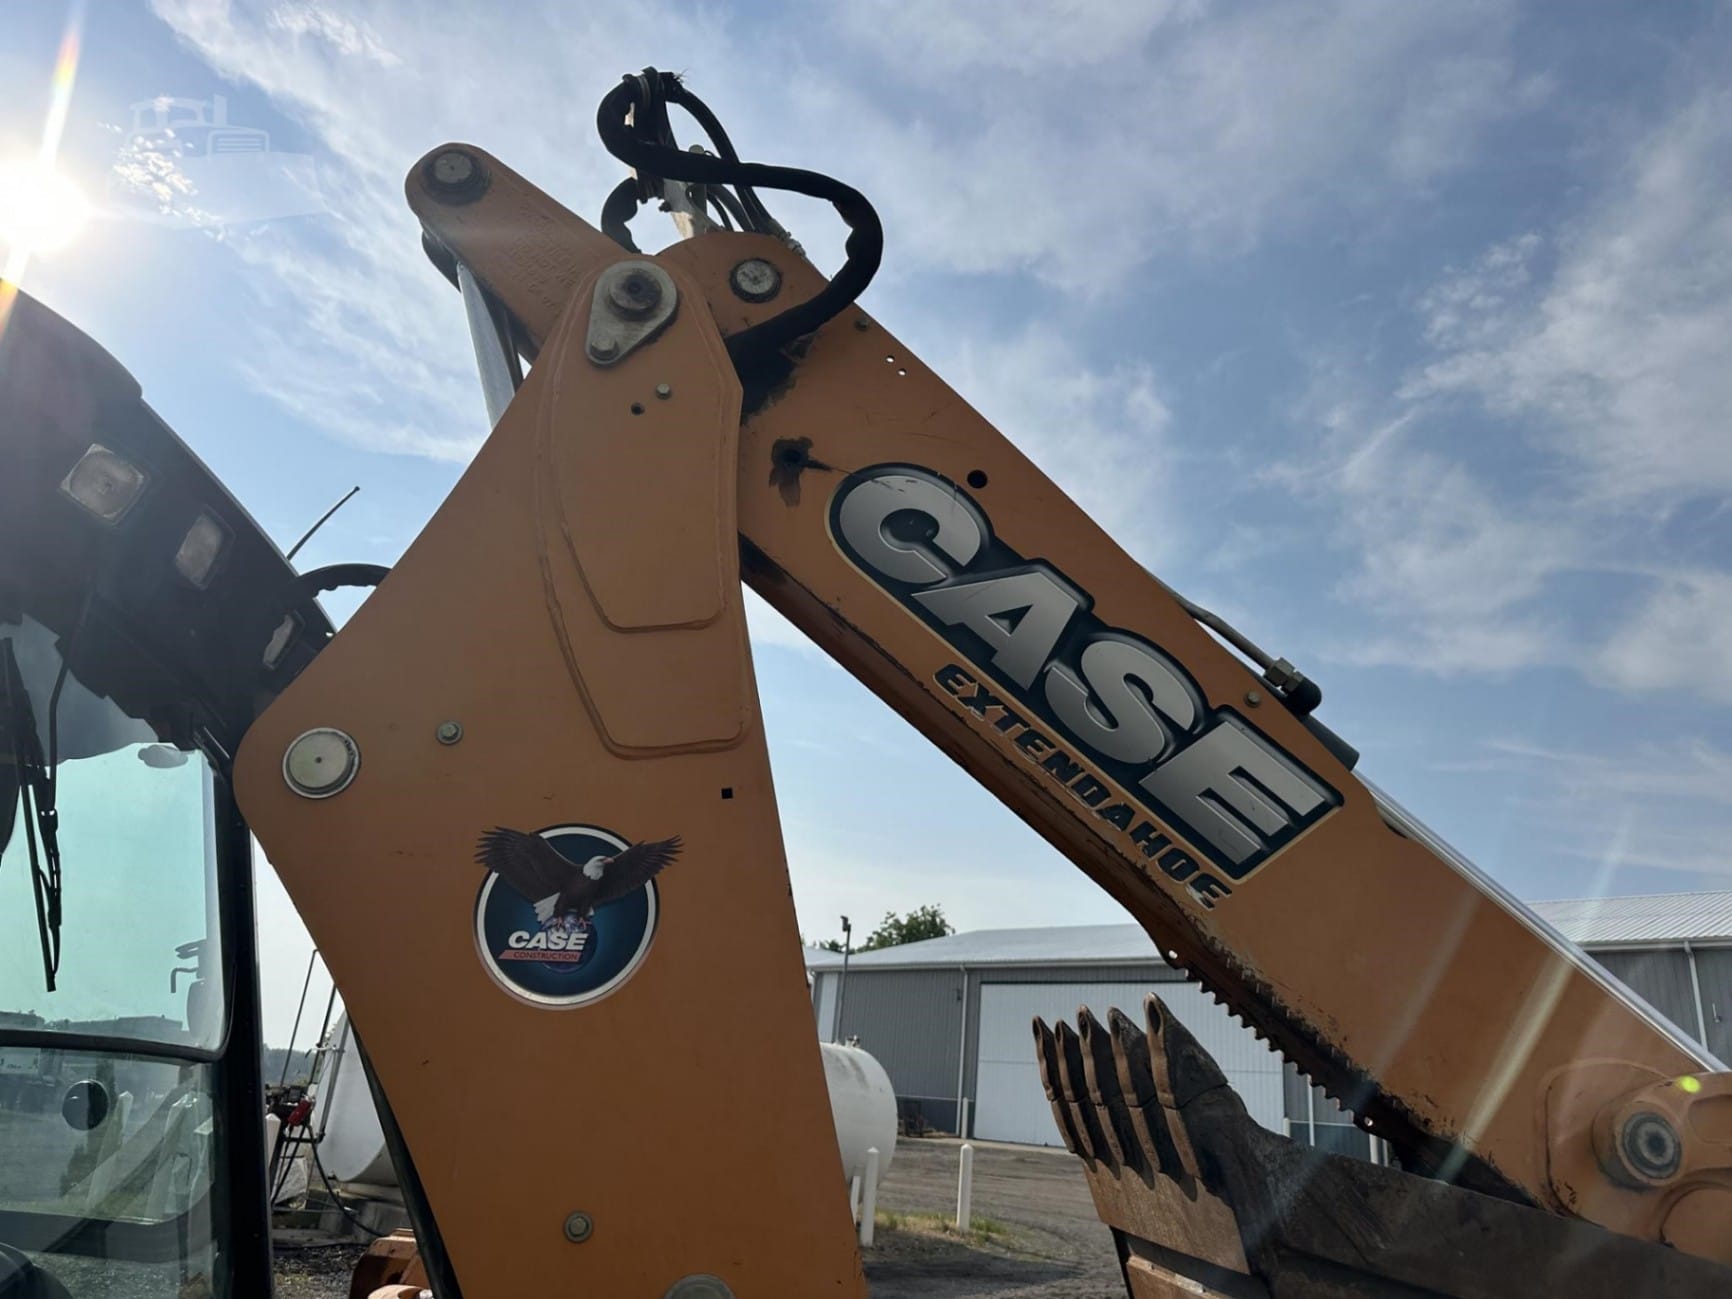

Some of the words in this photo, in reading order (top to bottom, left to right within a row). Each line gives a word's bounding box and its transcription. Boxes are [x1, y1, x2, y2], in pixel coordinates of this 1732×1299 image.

[836, 471, 1332, 868] CASE
[935, 664, 1233, 911] EXTENDAHOE
[508, 930, 588, 951] CASE
[513, 951, 577, 961] CONSTRUCTION
